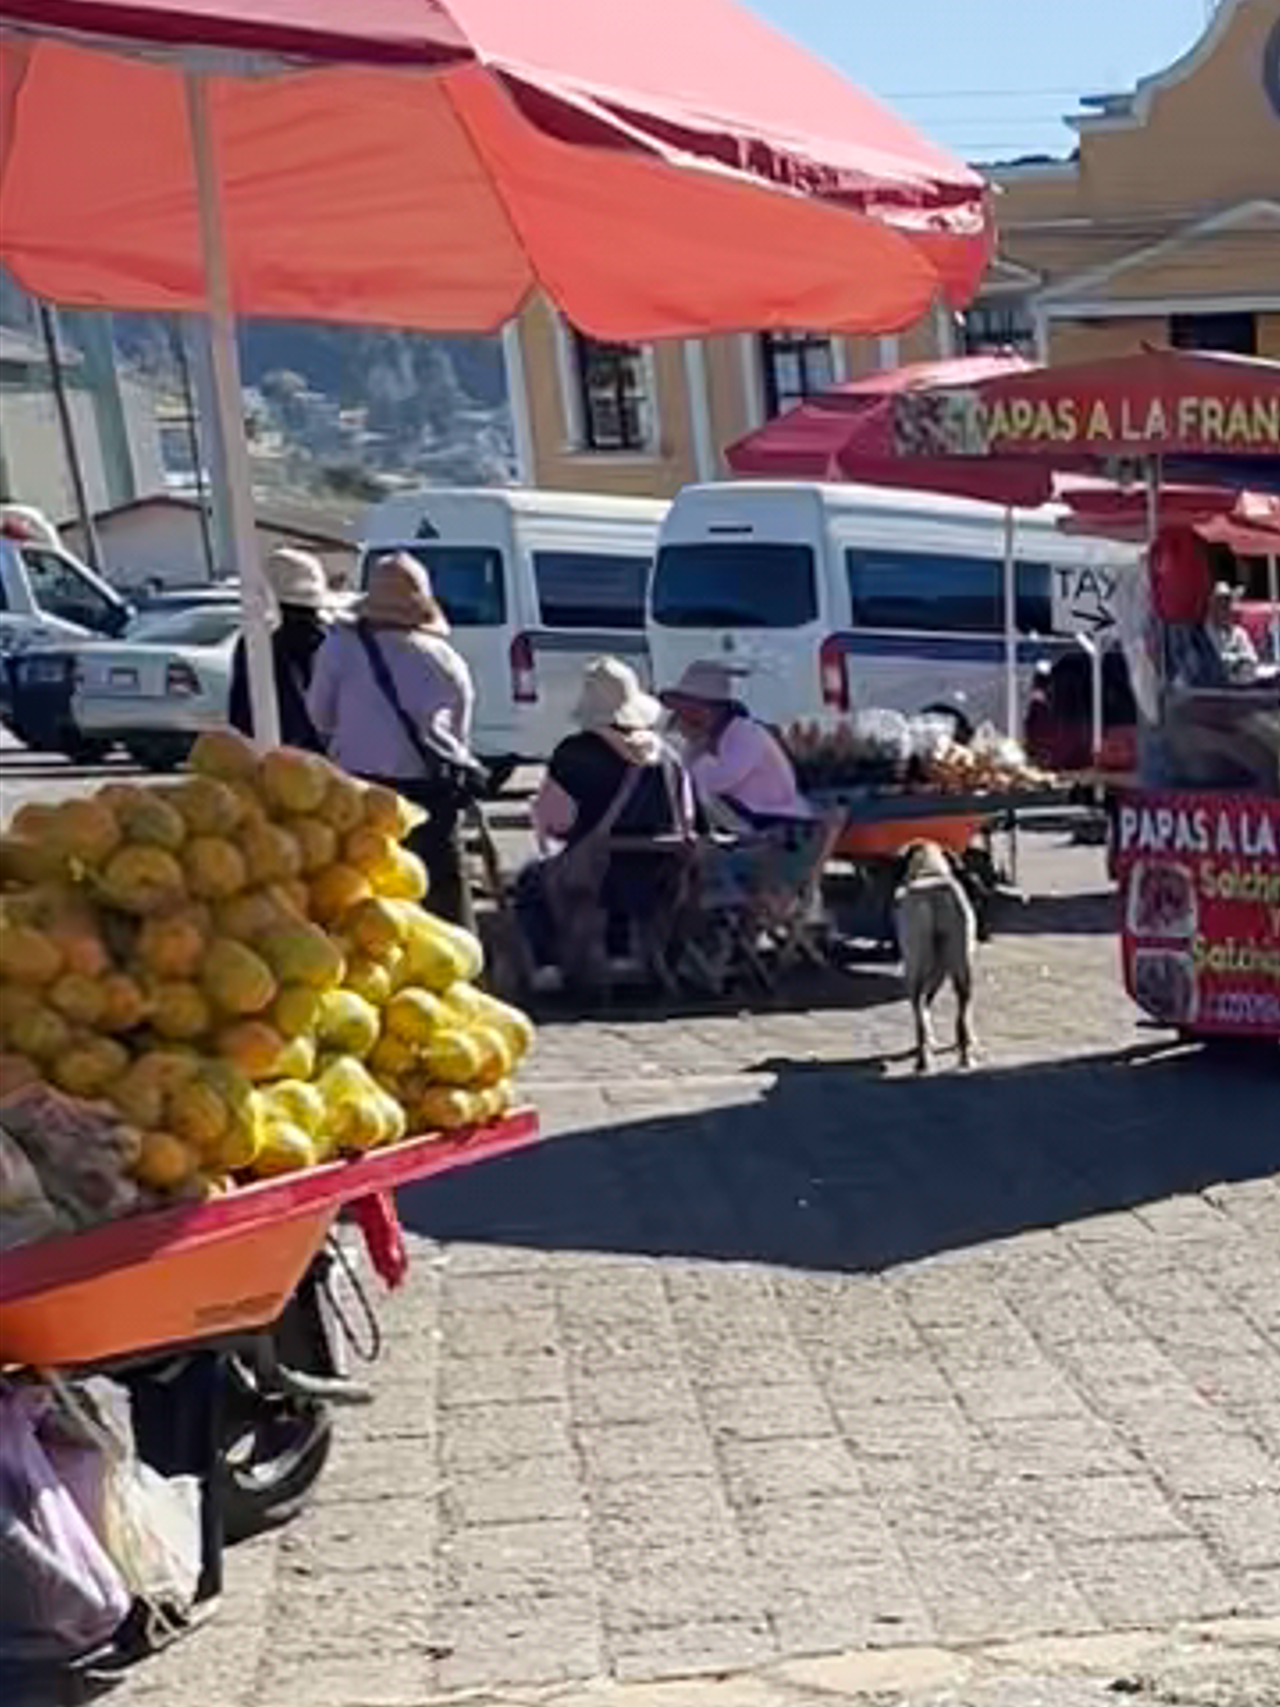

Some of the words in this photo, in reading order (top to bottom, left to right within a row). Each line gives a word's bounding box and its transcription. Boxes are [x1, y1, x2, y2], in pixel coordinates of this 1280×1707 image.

[1086, 398, 1113, 441] A
[1120, 398, 1167, 442] LA
[1119, 807, 1208, 851] PAPAS
[1217, 810, 1237, 852] A
[1240, 812, 1276, 854] LA
